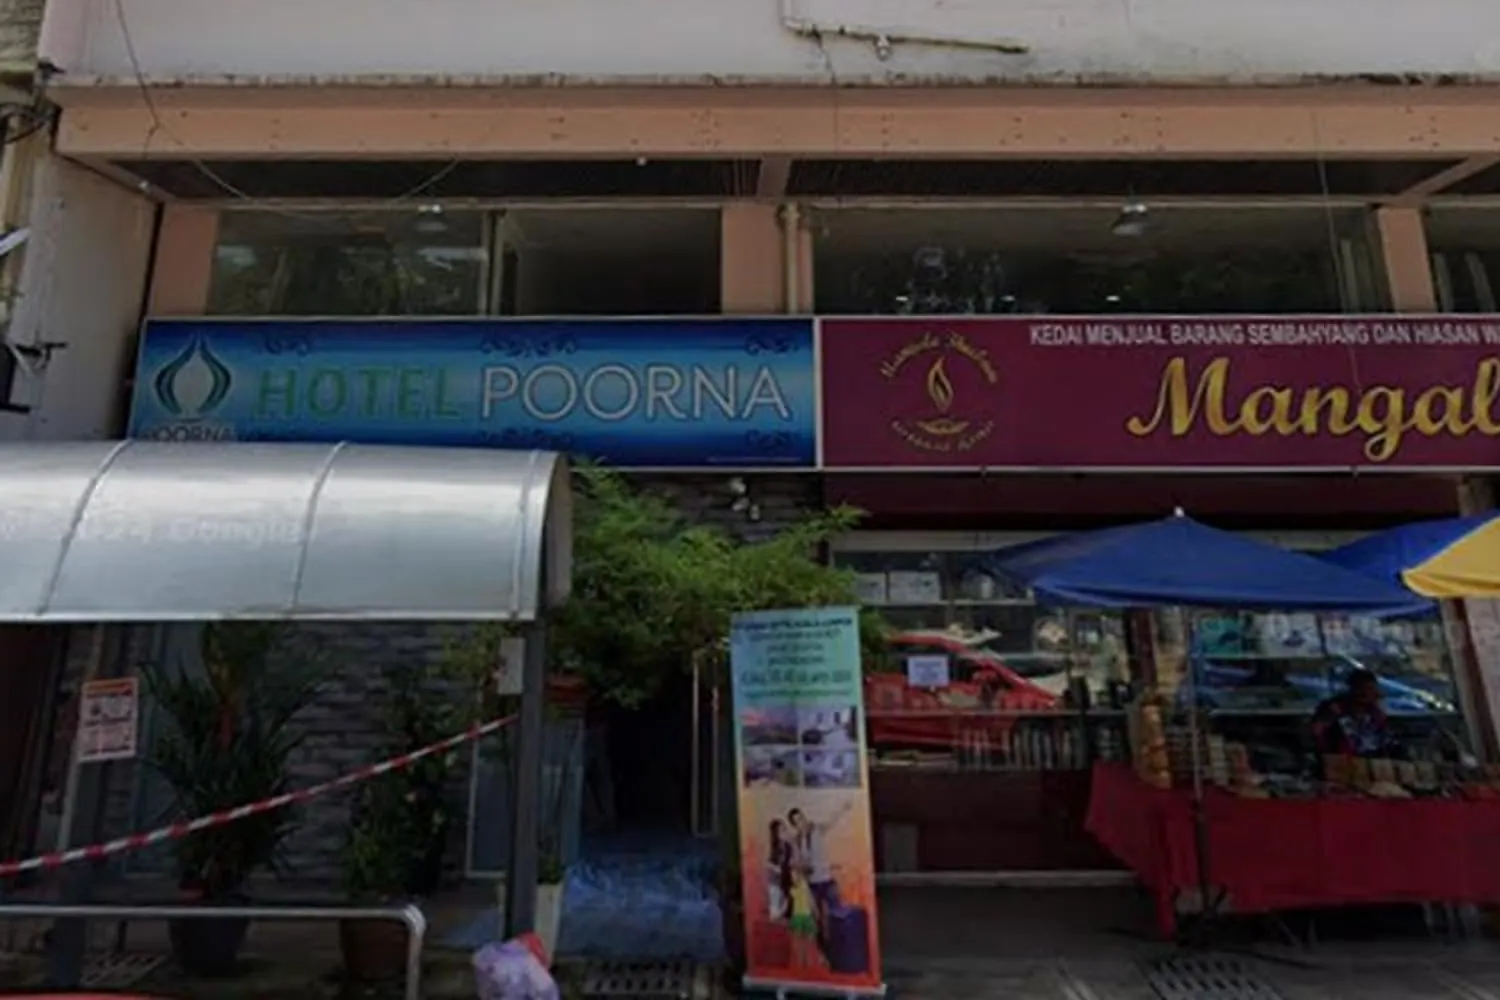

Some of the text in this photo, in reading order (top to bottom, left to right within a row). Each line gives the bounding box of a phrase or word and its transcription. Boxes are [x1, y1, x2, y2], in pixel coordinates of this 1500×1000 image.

[1031, 324, 1082, 344] KEDAI
[1086, 324, 1167, 344] MENJUAL
[1170, 324, 1244, 344] BARANG
[1248, 324, 1369, 344] SEMBAHYANG
[1373, 324, 1412, 344] DAN
[1415, 324, 1479, 344] HIASAN
[259, 364, 791, 421] HOTEL POORNA
